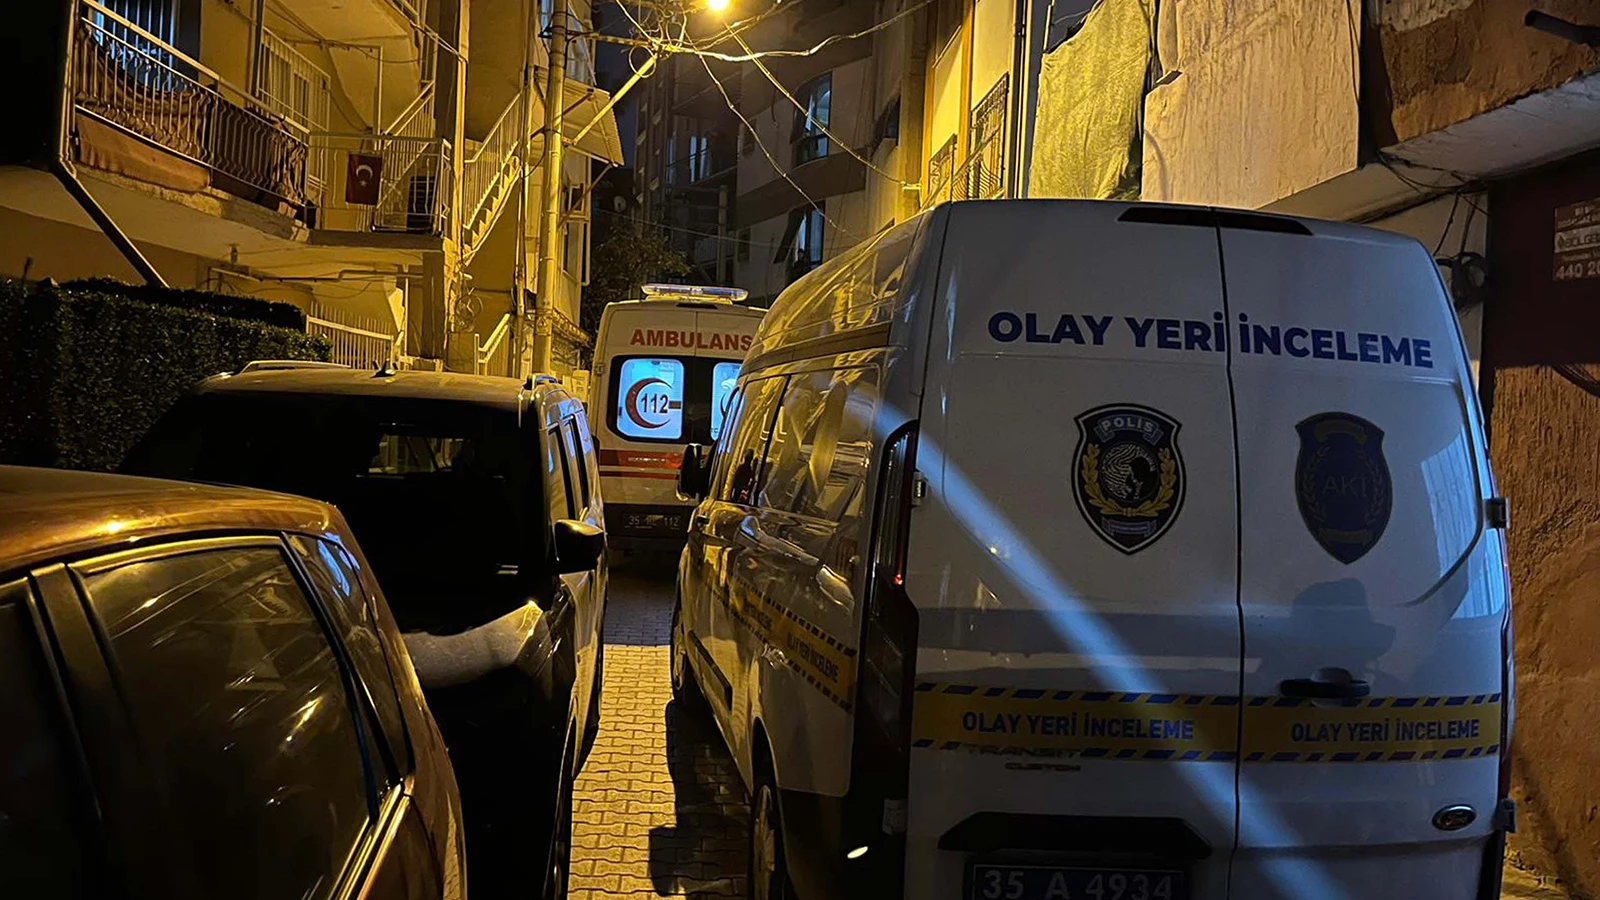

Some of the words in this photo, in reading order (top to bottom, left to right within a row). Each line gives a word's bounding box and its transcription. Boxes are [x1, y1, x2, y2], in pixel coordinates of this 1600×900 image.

[1556, 263, 1583, 280] 440
[629, 328, 753, 351] AMBULANS
[987, 311, 1114, 345] OLAY
[1124, 311, 1226, 352] YERİ
[1238, 312, 1434, 369] İNCELEME
[640, 392, 669, 414] 112
[962, 711, 1020, 734] OLAY
[1026, 712, 1077, 737] YERİ
[1083, 712, 1195, 740] İNCELEME
[1290, 722, 1343, 743] OLAY
[1346, 718, 1390, 742] YERİ
[1395, 717, 1480, 742] İNCELEME
[982, 869, 1025, 900] 35
[1044, 871, 1071, 900] A
[1084, 872, 1173, 900] 4934
